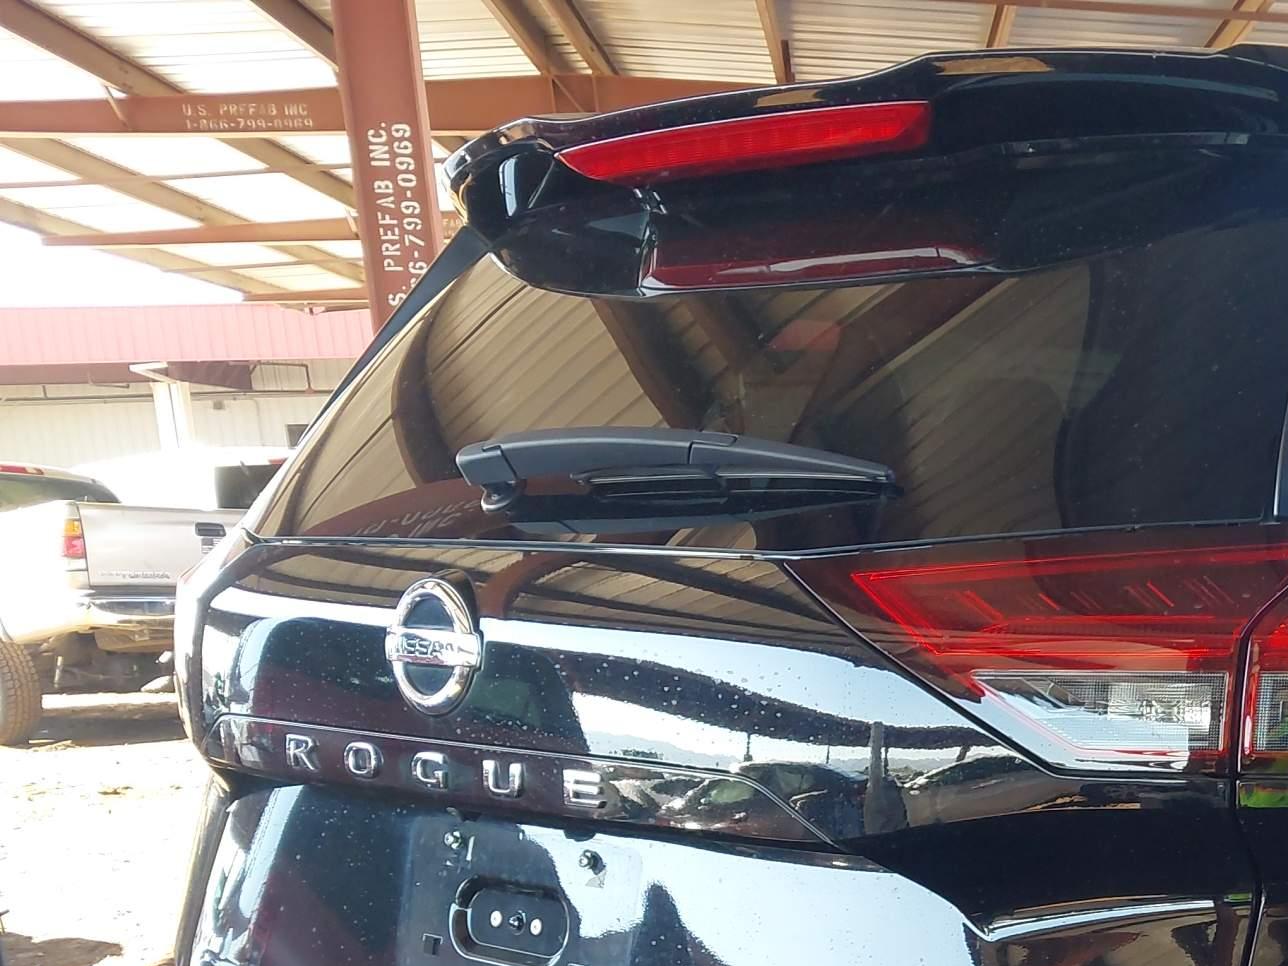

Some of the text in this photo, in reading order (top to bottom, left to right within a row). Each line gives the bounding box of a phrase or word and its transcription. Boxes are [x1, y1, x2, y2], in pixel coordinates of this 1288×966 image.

[367, 122, 391, 167] INC.
[373, 179, 405, 272] PREFAB
[285, 734, 608, 809] ROGUE
